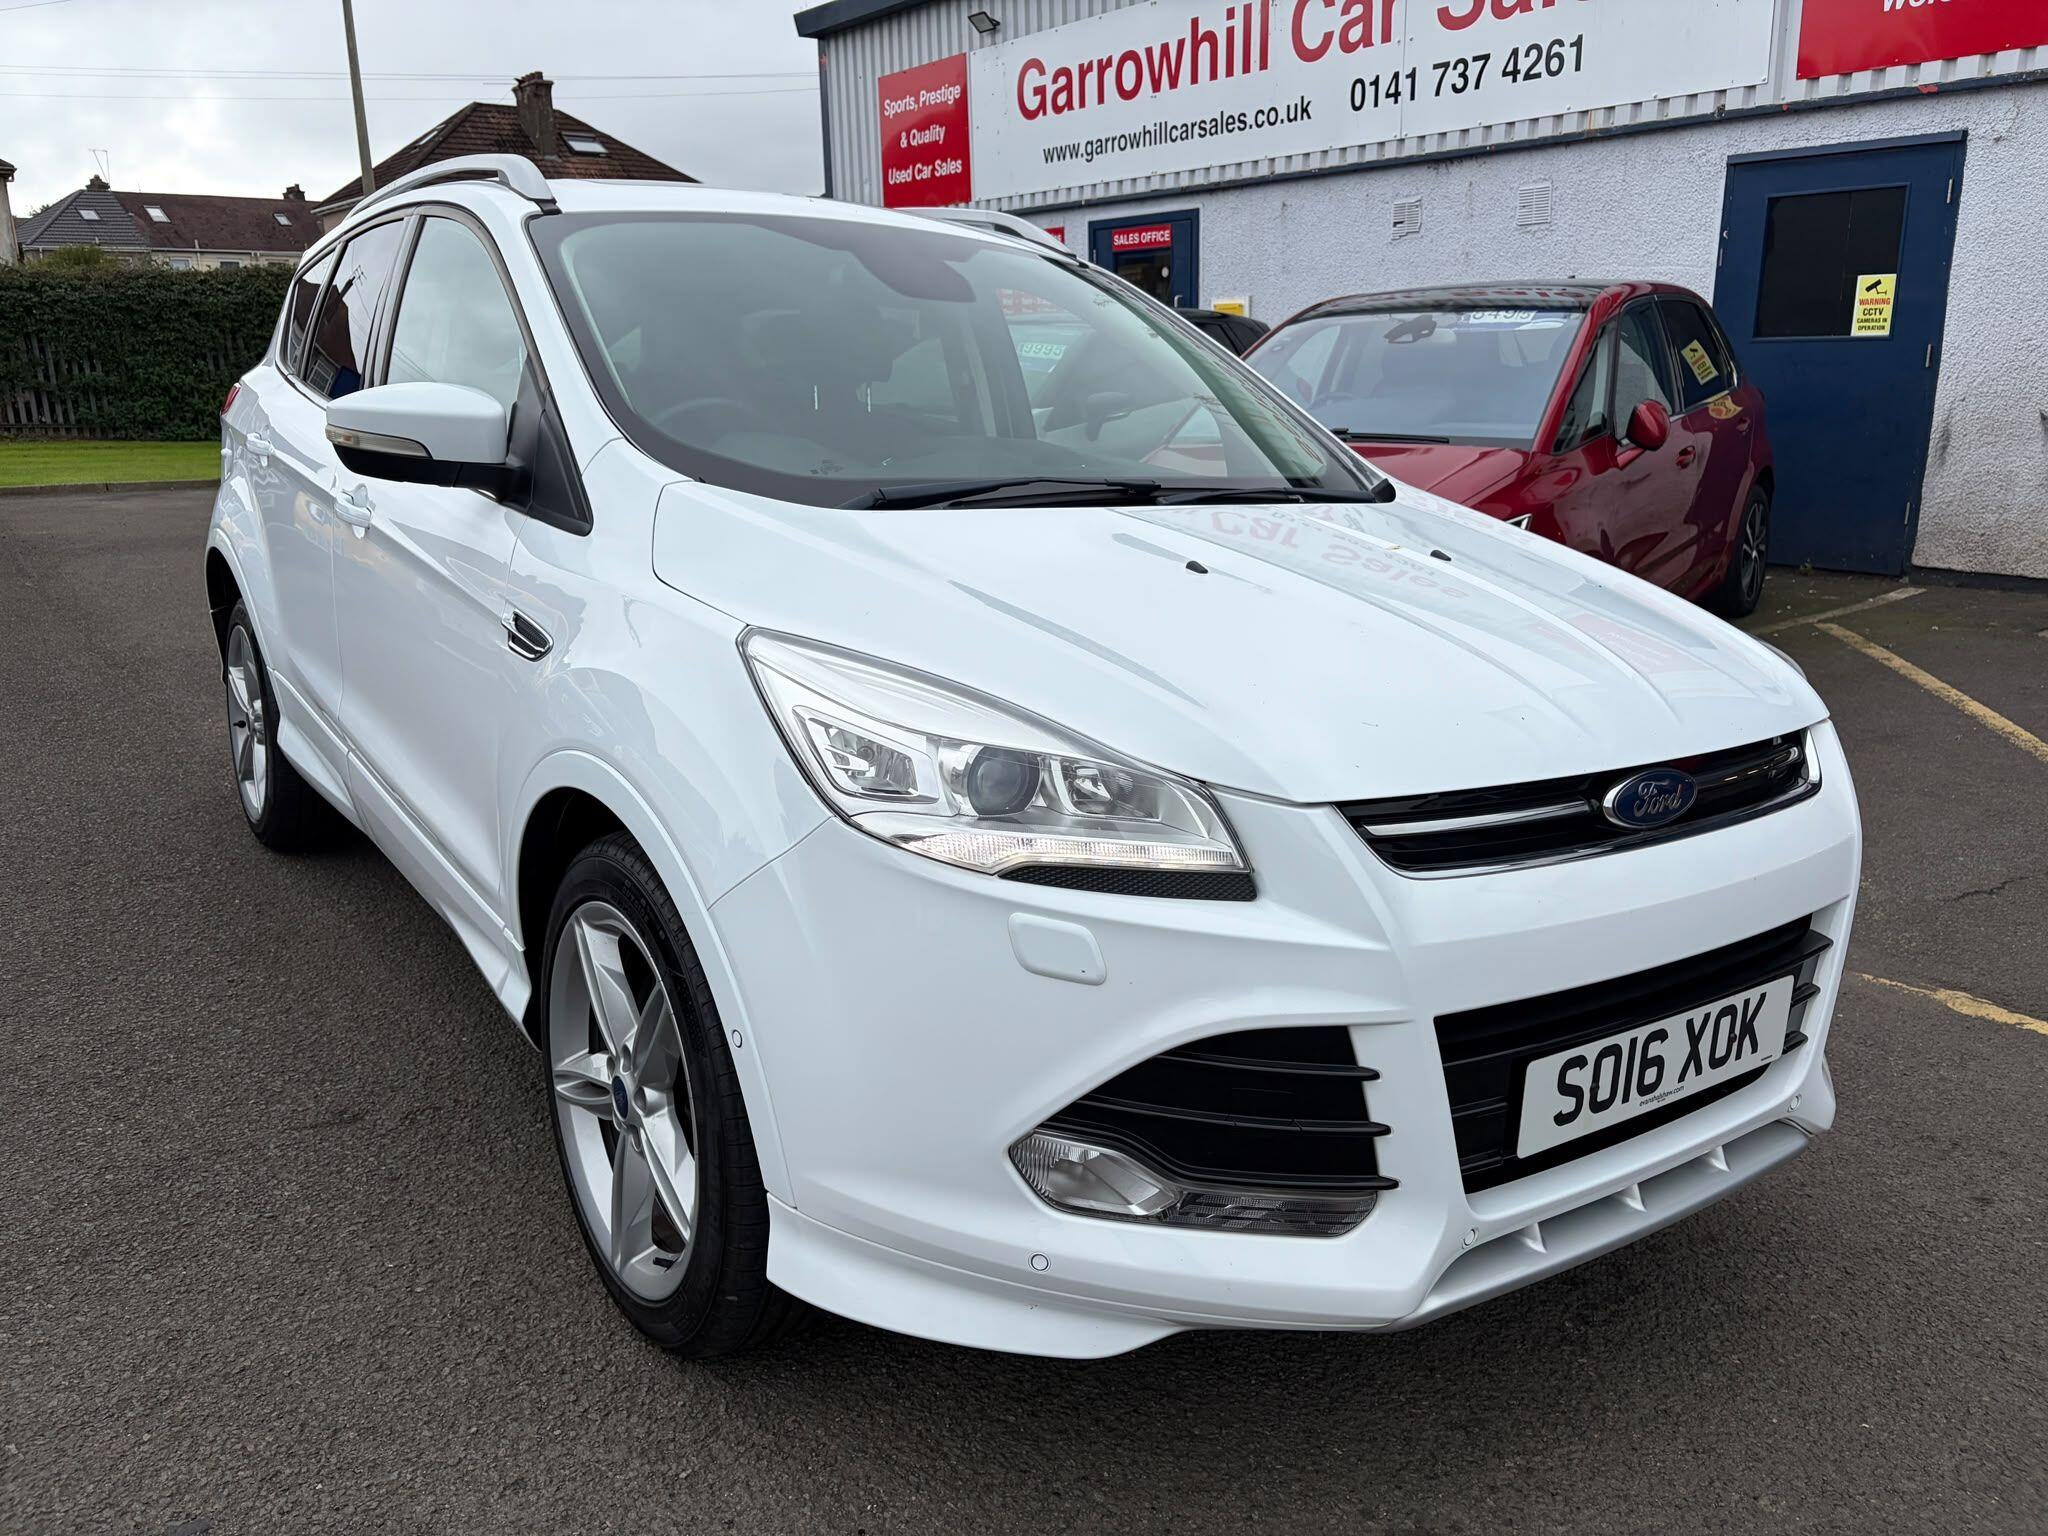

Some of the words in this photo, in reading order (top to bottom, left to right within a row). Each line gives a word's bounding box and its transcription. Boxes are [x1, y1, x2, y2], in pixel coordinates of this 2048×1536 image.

[1017, 0, 1270, 121] Garrowhill
[1291, 0, 1395, 63] Car
[1350, 67, 1417, 112] 0141
[1432, 53, 1491, 97] 737
[1501, 33, 1584, 83] 4261
[883, 94, 918, 119] Sports,
[919, 83, 961, 107] Prestige
[900, 131, 908, 148] &
[909, 124, 946, 146] Quality
[1042, 95, 1312, 164] www.garrowhillcarsales.co.uk
[888, 164, 913, 185] Used
[914, 163, 933, 180] Car
[934, 157, 963, 177] Sales
[1113, 232, 1140, 246] SALES
[1140, 230, 1170, 243] OFFICE
[1859, 298, 1891, 306] WARNING
[1862, 307, 1884, 316] CCTV
[1633, 779, 1683, 817] Ford
[1552, 1028, 1669, 1127] SO16
[1677, 992, 1767, 1084] XOK
